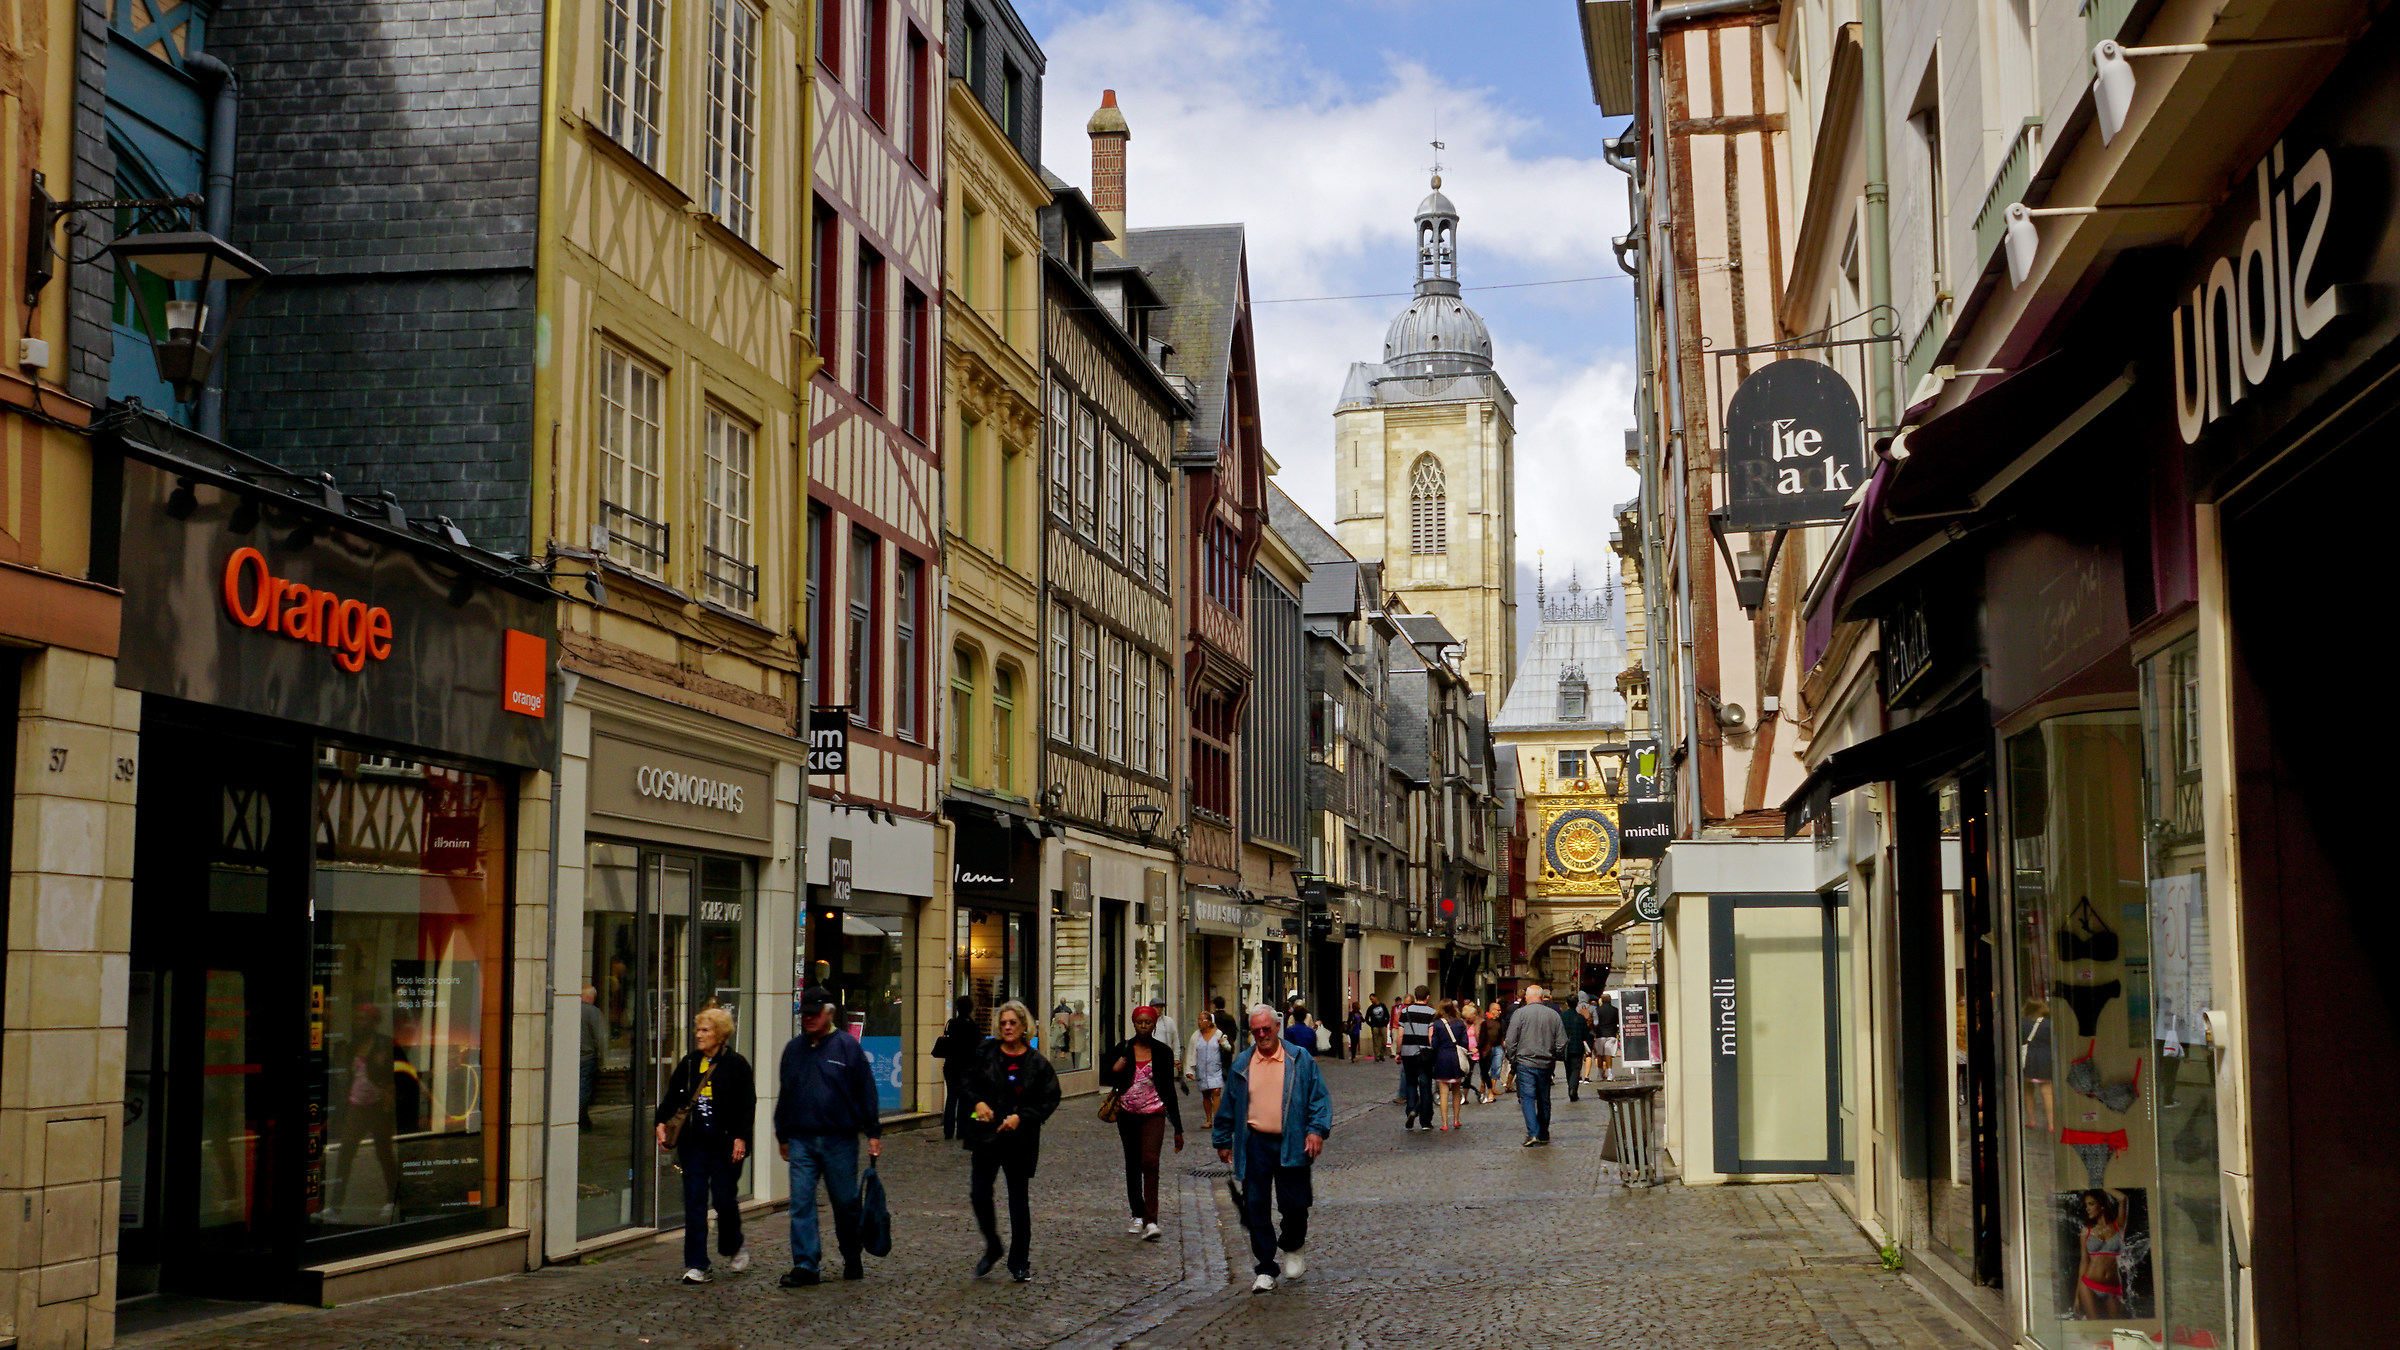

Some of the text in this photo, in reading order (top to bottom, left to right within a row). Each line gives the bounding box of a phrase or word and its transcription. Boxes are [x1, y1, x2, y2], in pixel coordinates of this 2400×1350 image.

[2172, 138, 2337, 445] undiz
[1771, 417, 1823, 463] Tie
[225, 546, 394, 673] Orange
[512, 690, 542, 712] orange
[48, 746, 69, 773] 37
[115, 757, 135, 782] 39
[637, 765, 744, 814] COSMOPARIS
[1624, 823, 1670, 838] minelli
[832, 857, 851, 882] pim
[834, 880, 851, 901] kie
[1712, 978, 1736, 1056] minelli
